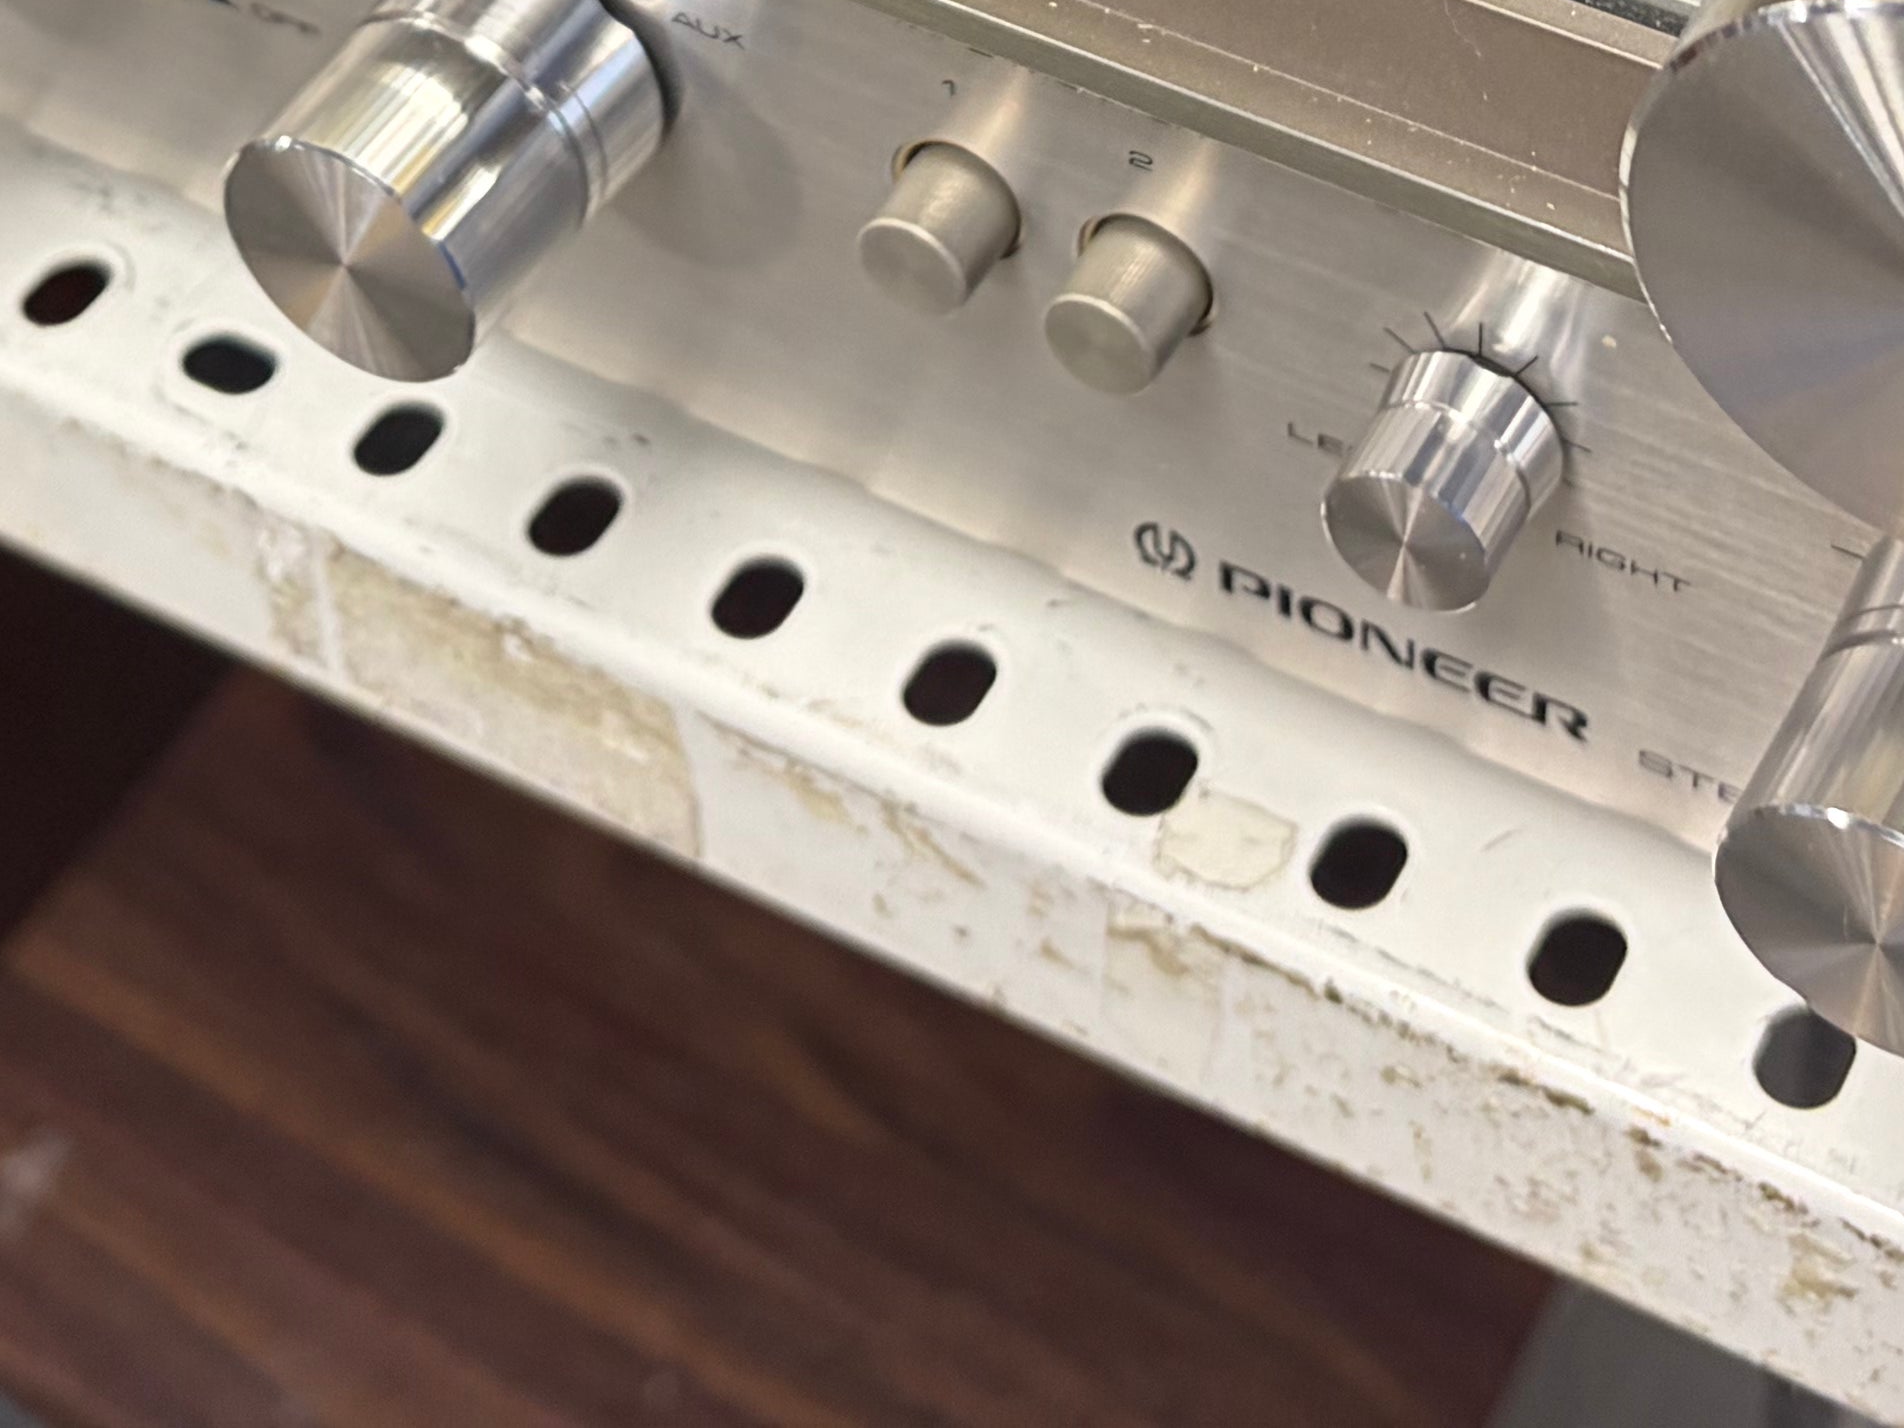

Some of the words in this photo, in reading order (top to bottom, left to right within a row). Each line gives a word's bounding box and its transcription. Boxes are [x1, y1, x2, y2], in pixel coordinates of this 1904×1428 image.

[671, 11, 746, 50] AUX
[1128, 149, 1154, 173] 2
[1555, 529, 1692, 594] RIGHT
[1216, 559, 1590, 743] PIONEER
[1638, 748, 1741, 804] STE
